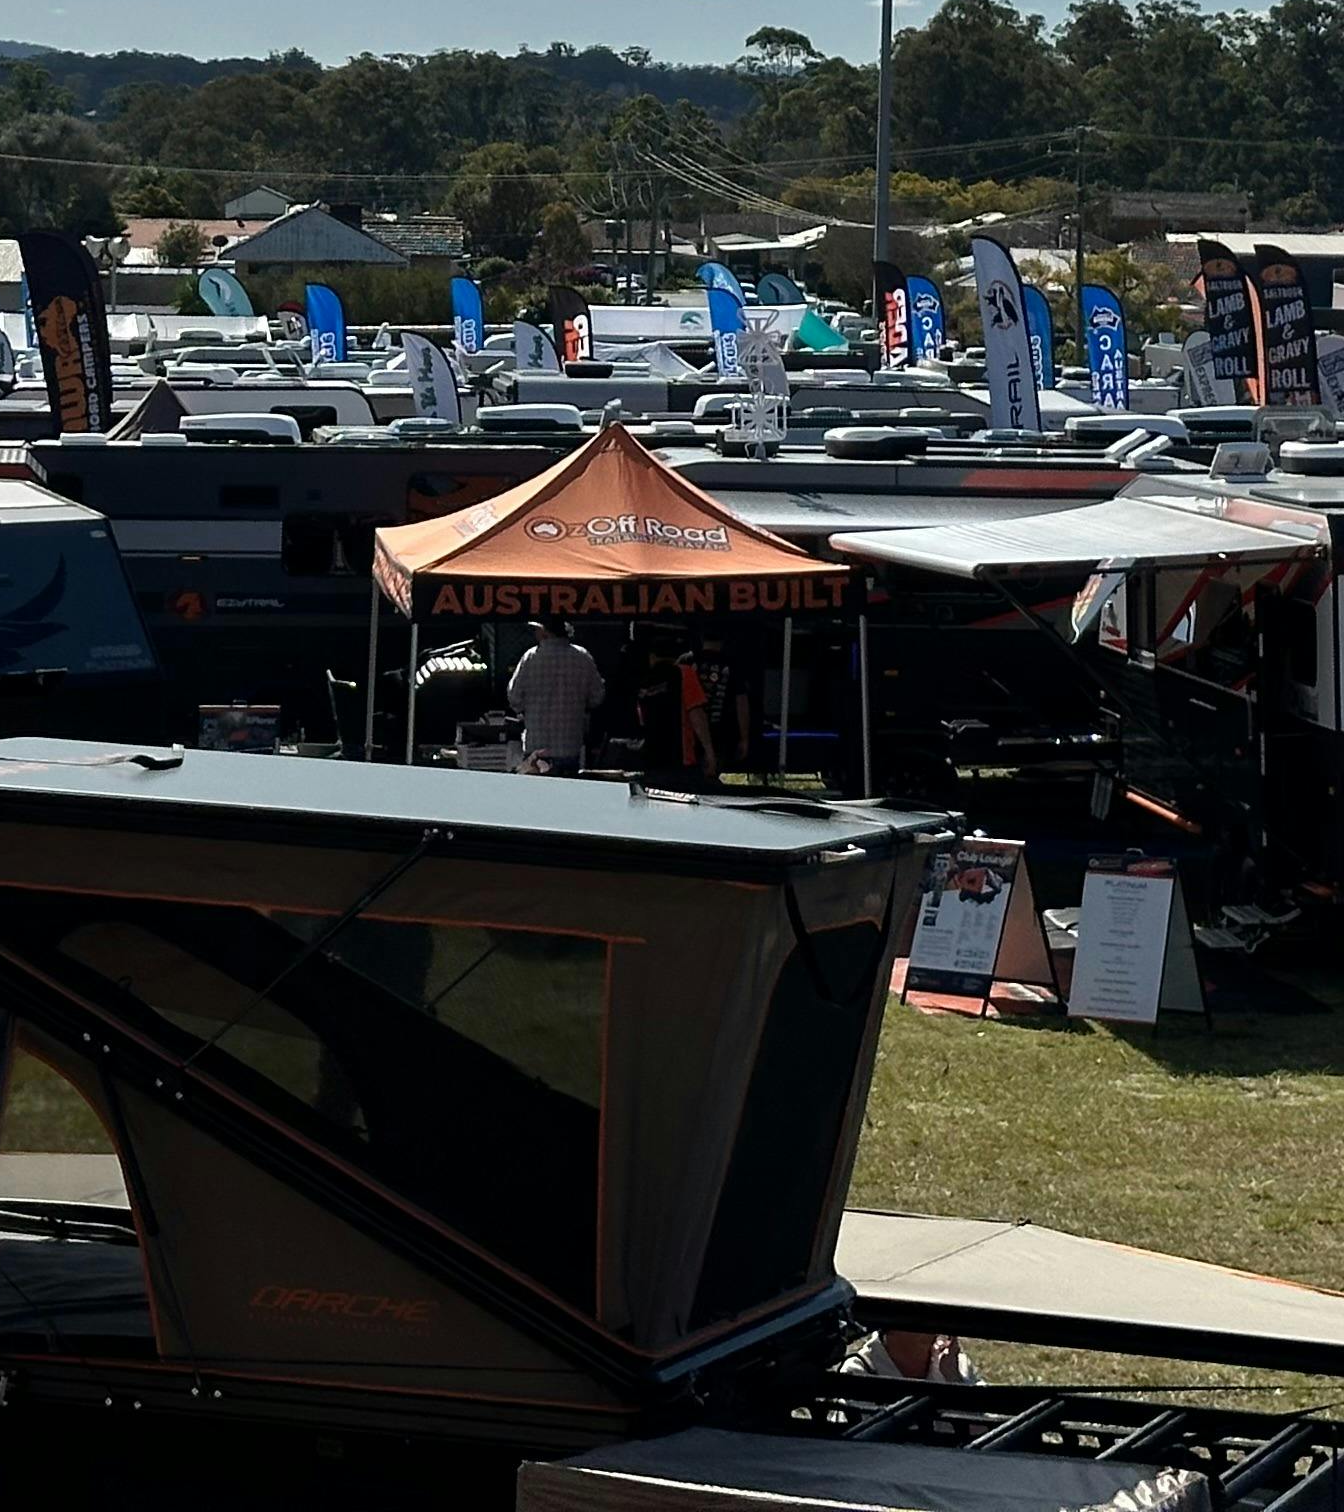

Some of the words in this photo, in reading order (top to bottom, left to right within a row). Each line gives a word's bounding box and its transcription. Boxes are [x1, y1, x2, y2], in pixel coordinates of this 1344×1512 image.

[1208, 292, 1246, 320] LAMB
[1266, 299, 1307, 329] LAMB
[1222, 314, 1234, 330] &
[1281, 323, 1295, 339] &
[1210, 328, 1250, 354] GRAVY
[1268, 336, 1311, 364] GRAVY
[1214, 355, 1251, 378] ROLL
[1269, 366, 1311, 389] ROLL
[1006, 355, 1025, 429] RAIL
[431, 582, 718, 617] AUSTRALIAN
[729, 576, 850, 612] BUILT
